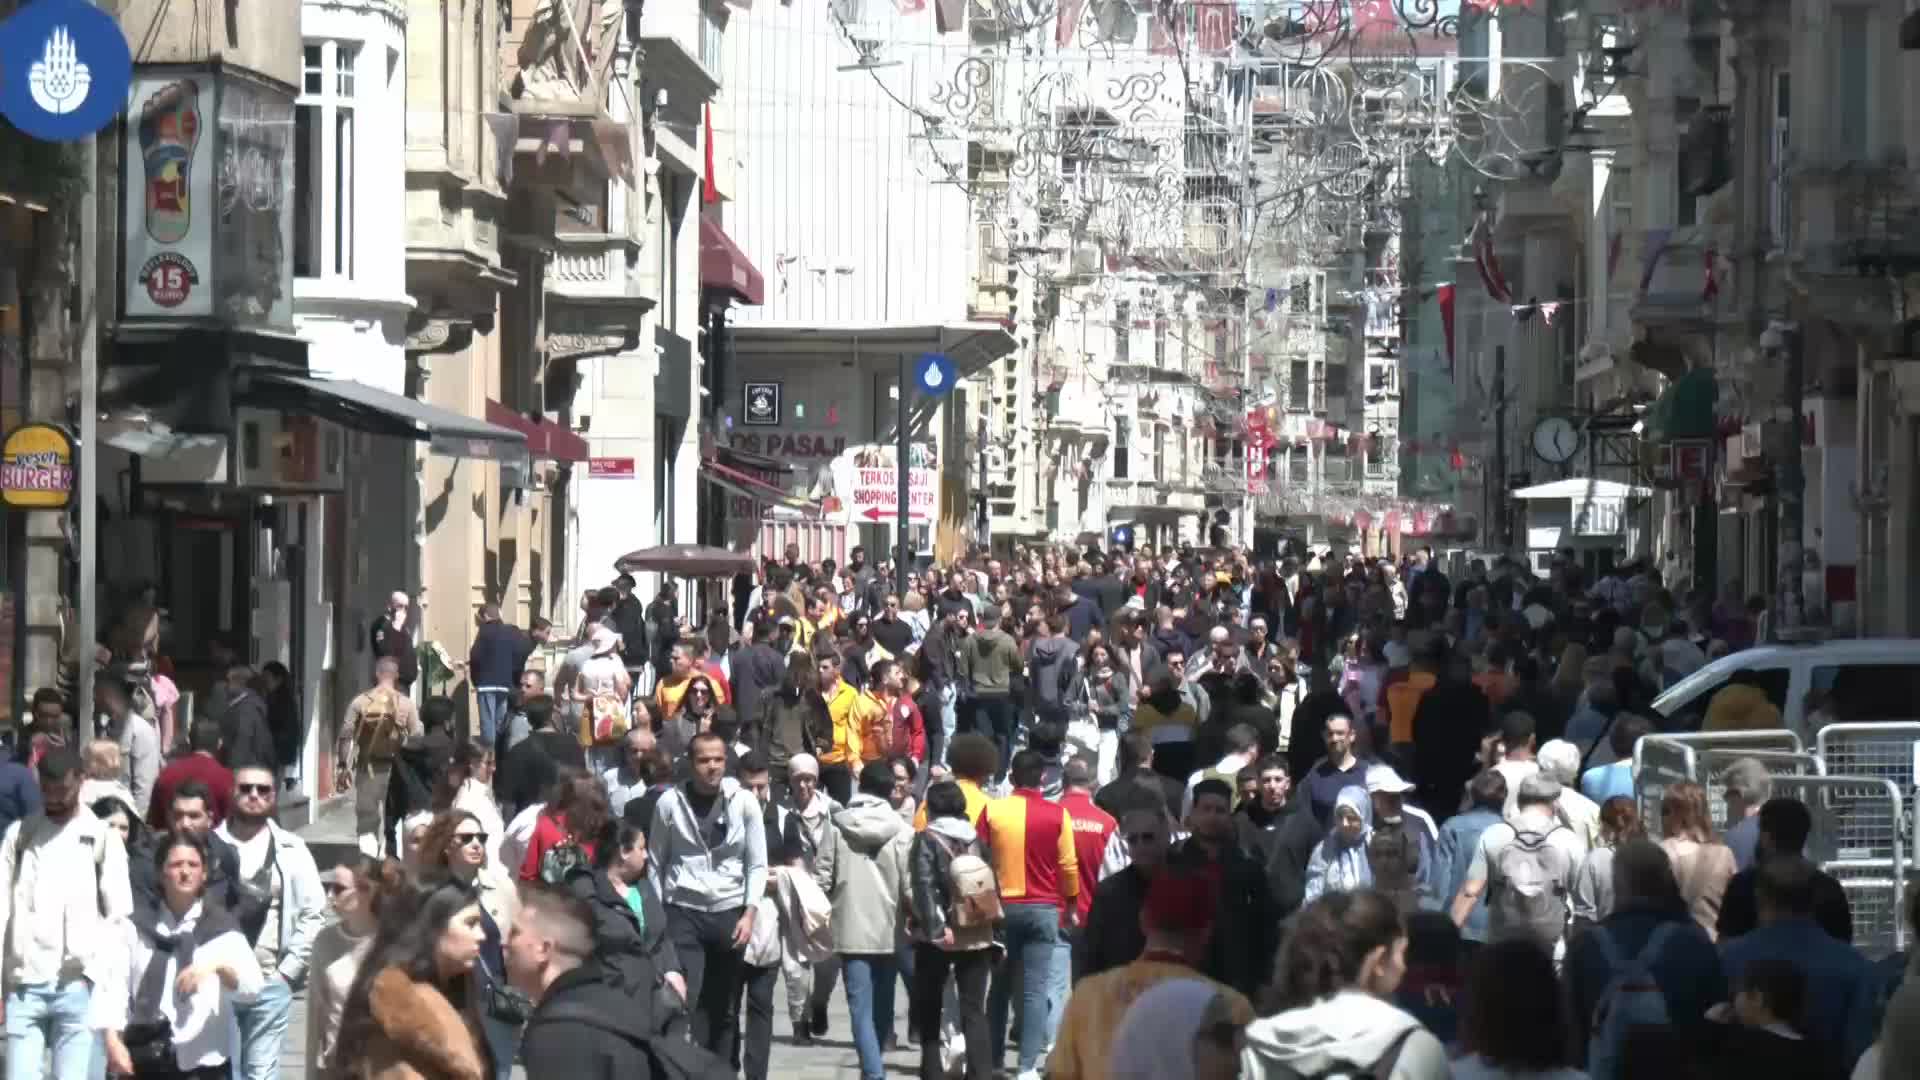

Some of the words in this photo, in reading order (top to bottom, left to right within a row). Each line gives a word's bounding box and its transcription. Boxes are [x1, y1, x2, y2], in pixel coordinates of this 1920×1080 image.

[151, 267, 183, 289] 15
[0, 465, 73, 490] BURGER
[860, 470, 895, 486] TERKOS
[853, 490, 897, 505] SHOPPING
